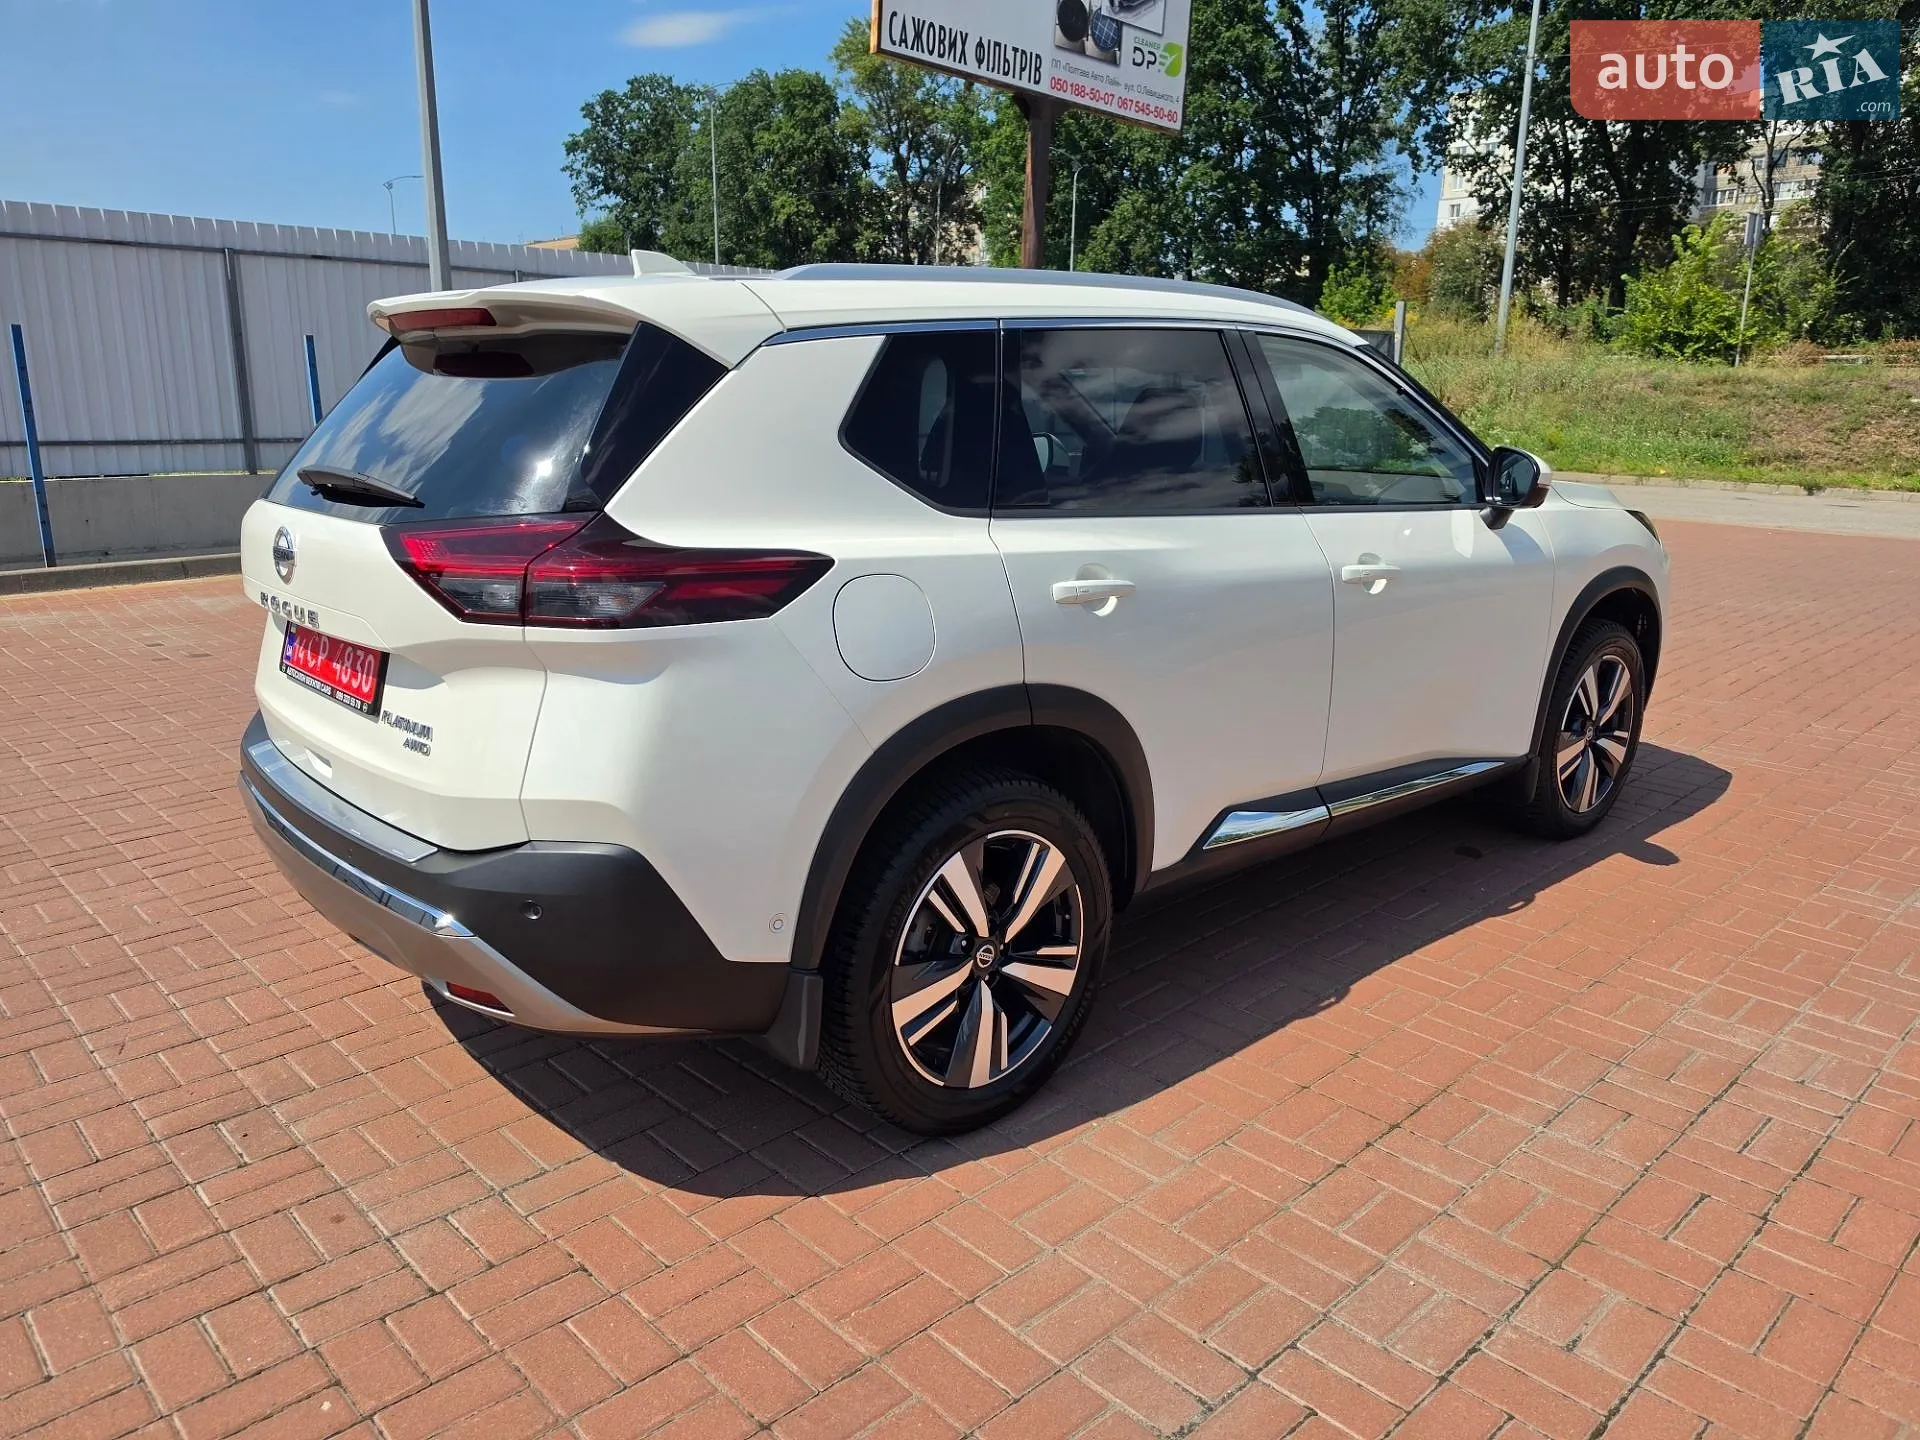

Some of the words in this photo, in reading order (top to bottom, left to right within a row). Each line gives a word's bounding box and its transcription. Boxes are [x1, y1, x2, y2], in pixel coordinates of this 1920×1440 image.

[888, 10, 969, 66] САЖОВИХ
[975, 36, 1043, 86] ФІЛЬТРІВ
[1050, 76, 1068, 94] 050
[1070, 82, 1115, 106] 188-50-07
[1117, 95, 1134, 112] 067
[1134, 100, 1178, 124] 545-50-60
[260, 591, 320, 630] ROGUE
